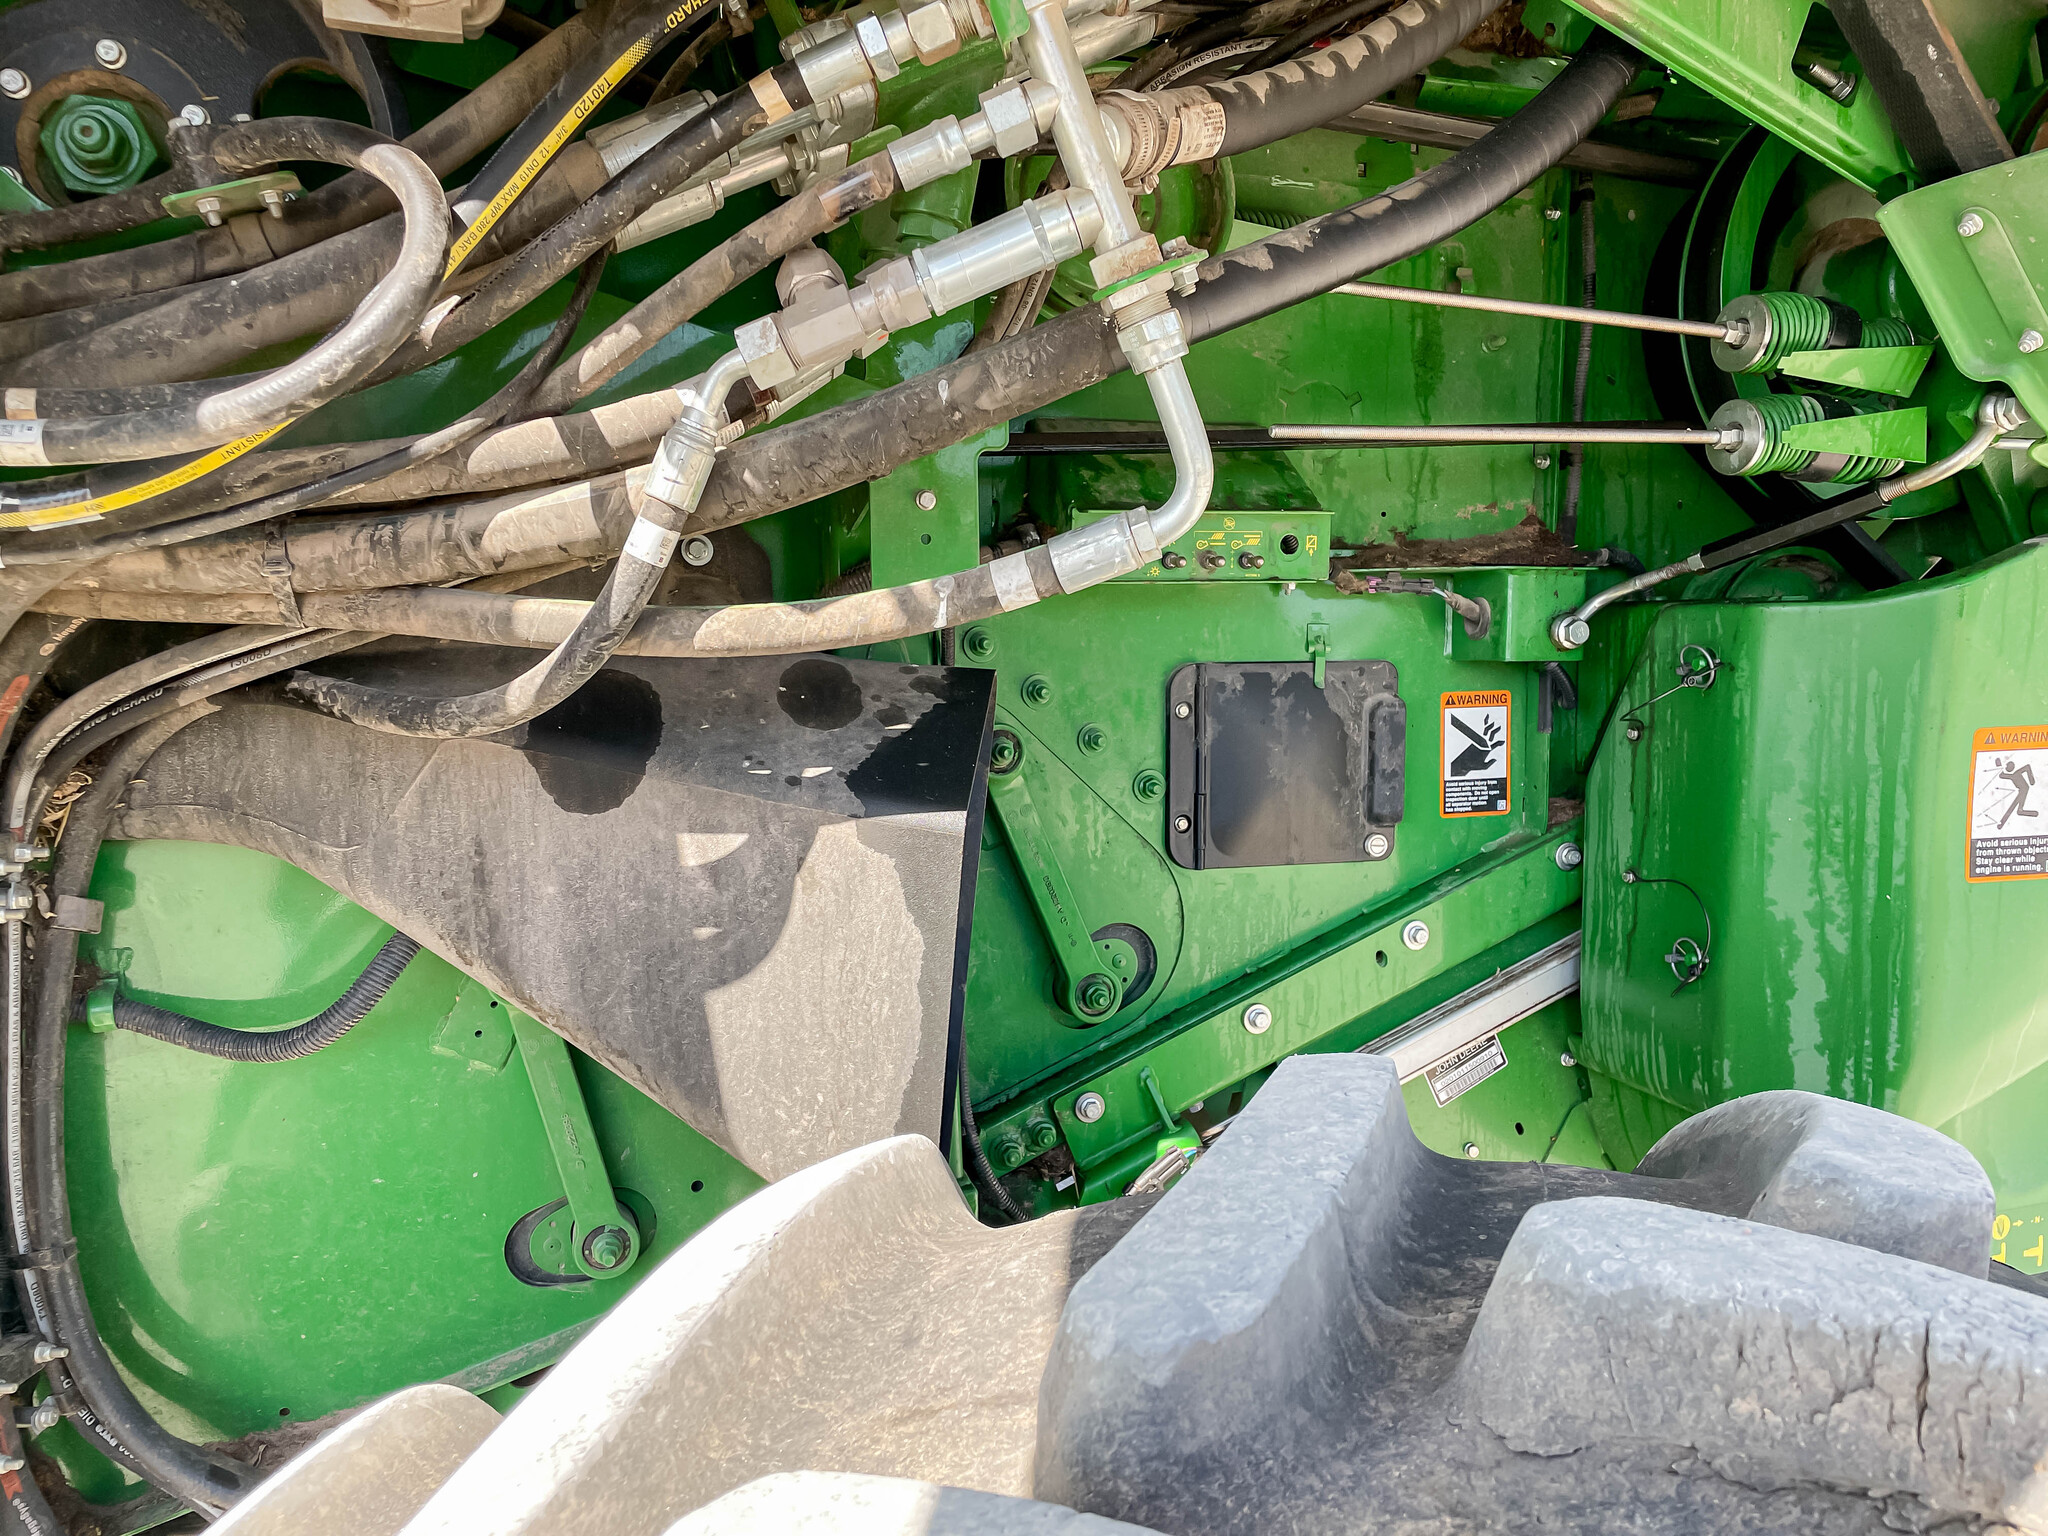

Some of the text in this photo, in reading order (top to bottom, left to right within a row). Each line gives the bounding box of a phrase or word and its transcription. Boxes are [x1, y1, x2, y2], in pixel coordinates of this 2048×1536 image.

[1149, 43, 1243, 92] ABRASION RESISTANT
[573, 76, 613, 120] T4012D
[518, 158, 541, 183] DN19
[499, 181, 520, 204] MAX
[490, 203, 505, 220] WP
[476, 216, 491, 234] 280
[459, 231, 478, 252] BAR
[1456, 693, 1508, 706] WARNING
[1976, 839, 1999, 848] Avoid
[2000, 838, 2028, 847] serious
[1976, 848, 1994, 857] from
[1995, 847, 2022, 856] thrown
[1975, 854, 2036, 867] Stay clear while
[1975, 863, 2044, 875] engine is running.
[1434, 1054, 1460, 1076] JOHN
